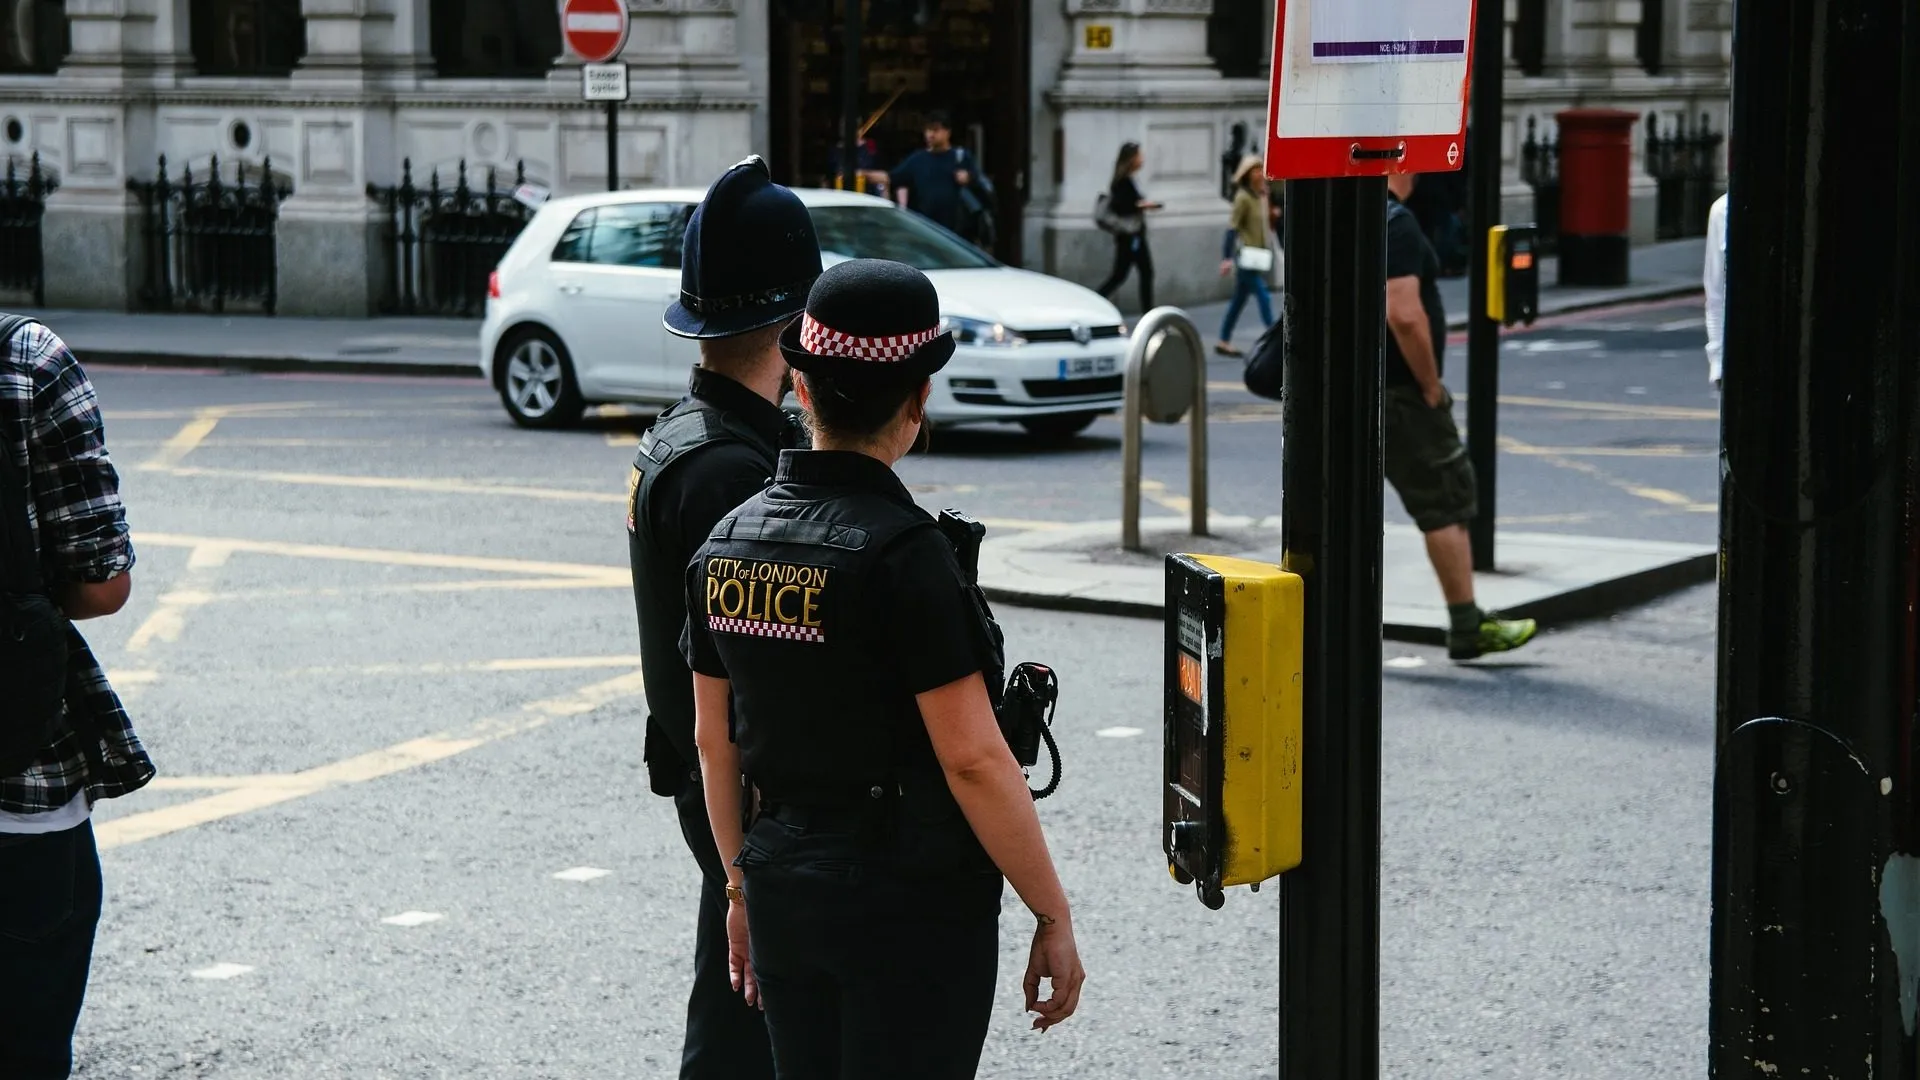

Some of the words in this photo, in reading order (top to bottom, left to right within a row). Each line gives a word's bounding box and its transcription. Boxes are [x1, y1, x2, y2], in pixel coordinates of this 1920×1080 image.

[708, 558, 742, 579] CITY
[750, 562, 828, 588] LONDON
[707, 576, 822, 627] POLICE
